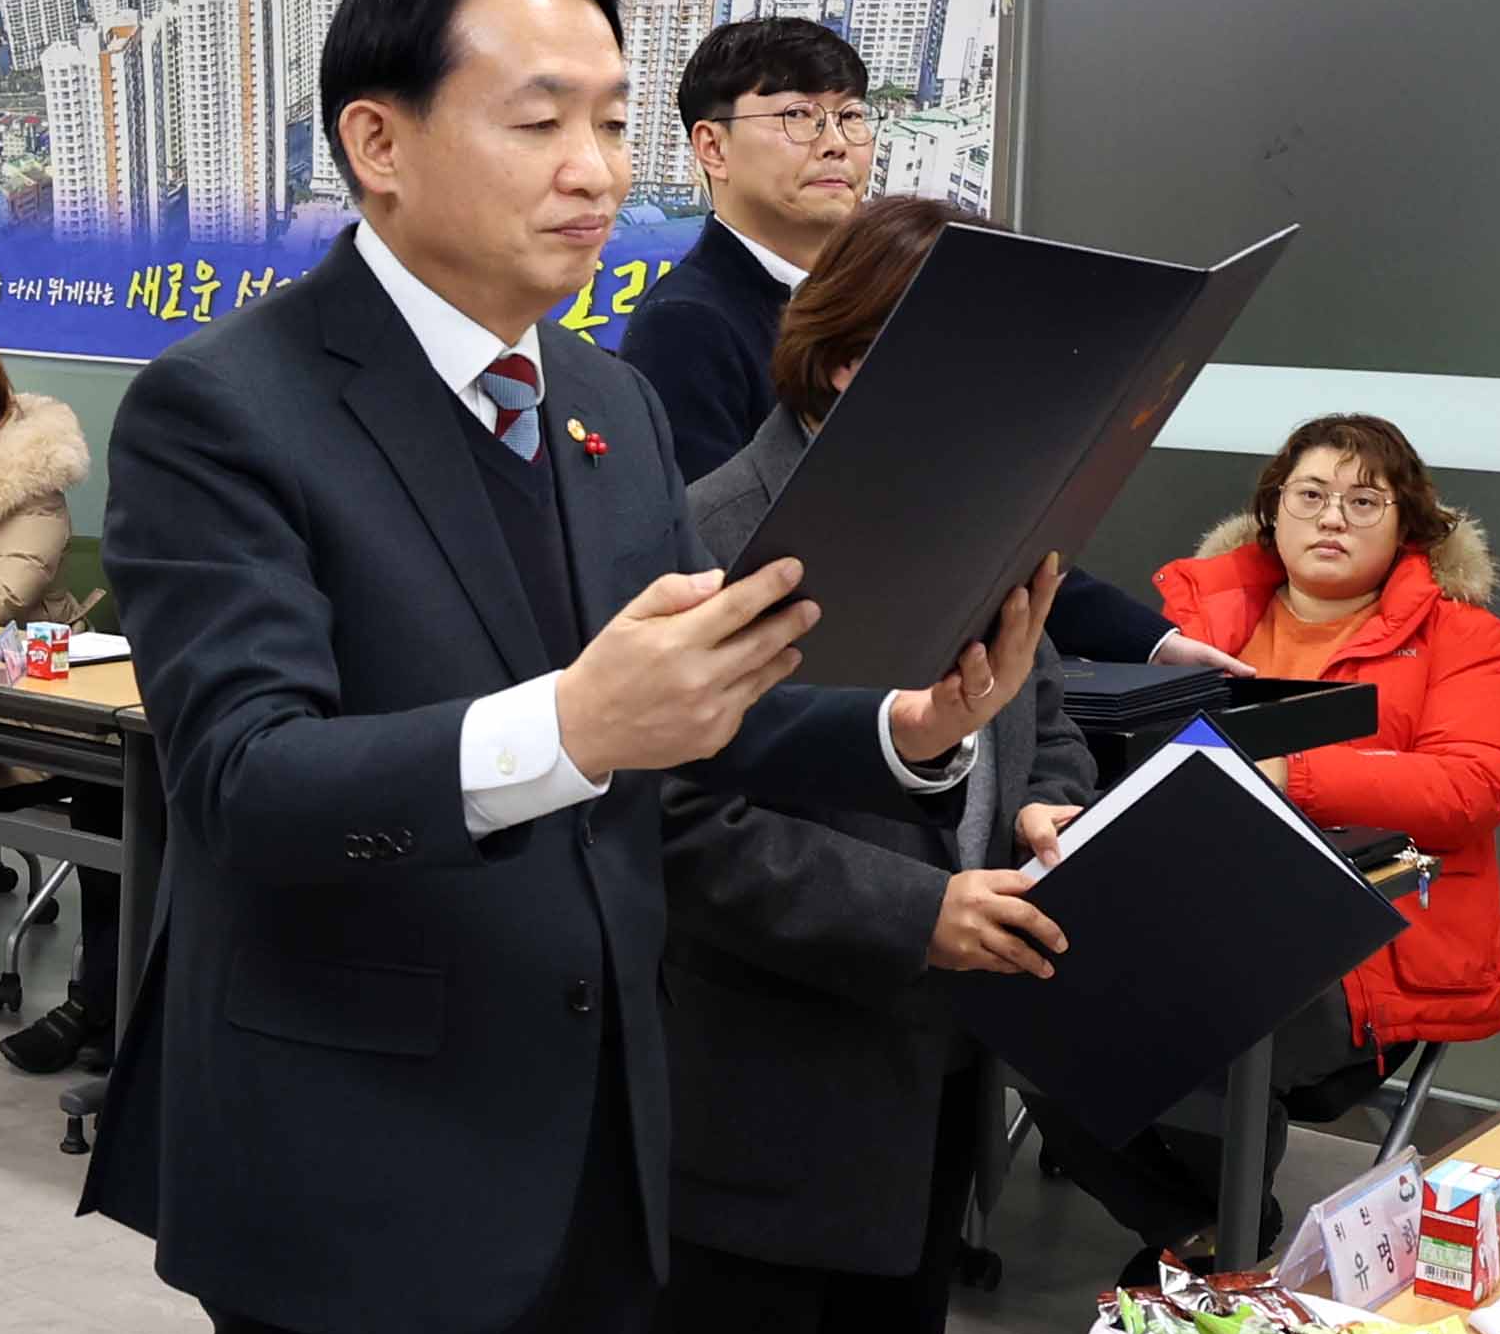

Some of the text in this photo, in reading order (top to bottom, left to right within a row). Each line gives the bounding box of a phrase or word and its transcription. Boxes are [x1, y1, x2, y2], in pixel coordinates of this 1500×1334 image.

[7, 276, 42, 301] 다시
[47, 277, 115, 307] 뛰게하는
[126, 259, 221, 323] 새로운
